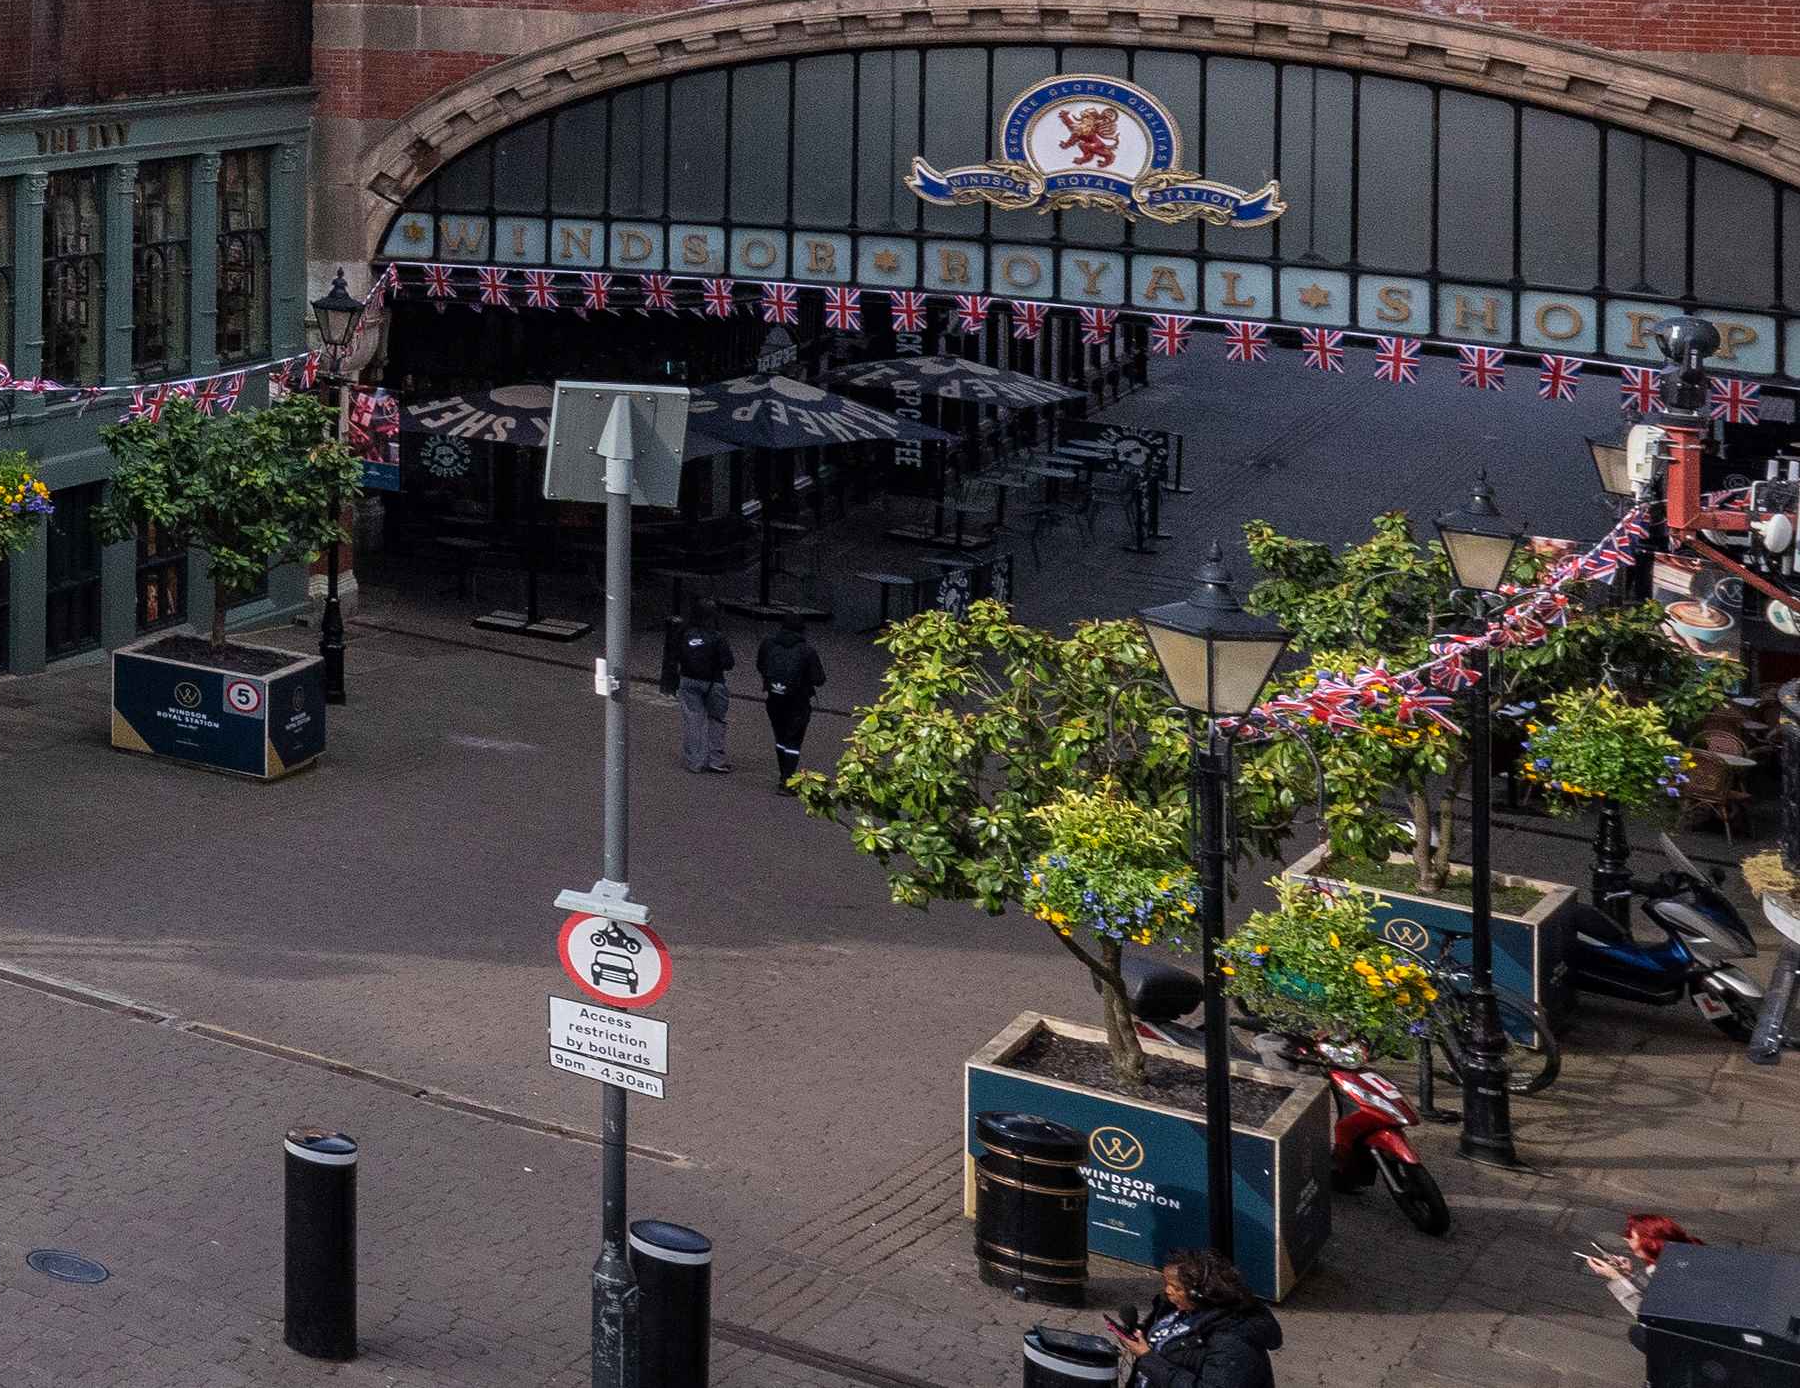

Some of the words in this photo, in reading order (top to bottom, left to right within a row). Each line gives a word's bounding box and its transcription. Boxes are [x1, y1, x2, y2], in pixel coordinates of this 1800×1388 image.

[1048, 81, 1118, 98] GLORIA
[951, 175, 1027, 193] WINDSOR
[1055, 177, 1119, 192] ROYAL
[1153, 188, 1236, 209] STATION
[438, 221, 838, 275] WINDSOR
[936, 247, 1256, 308] ROYAL
[237, 688, 251, 706] 5
[156, 710, 182, 722] ROYAL
[185, 716, 220, 729] STATION
[579, 1007, 632, 1030] Access
[568, 1022, 648, 1049] restriction
[566, 1036, 583, 1050] by
[589, 1041, 651, 1066] bollards
[554, 1053, 586, 1071] 9pm
[600, 1067, 659, 1093] 4.30am
[1078, 1165, 1156, 1194] WINDSOR
[1111, 1184, 1181, 1210] STATION
